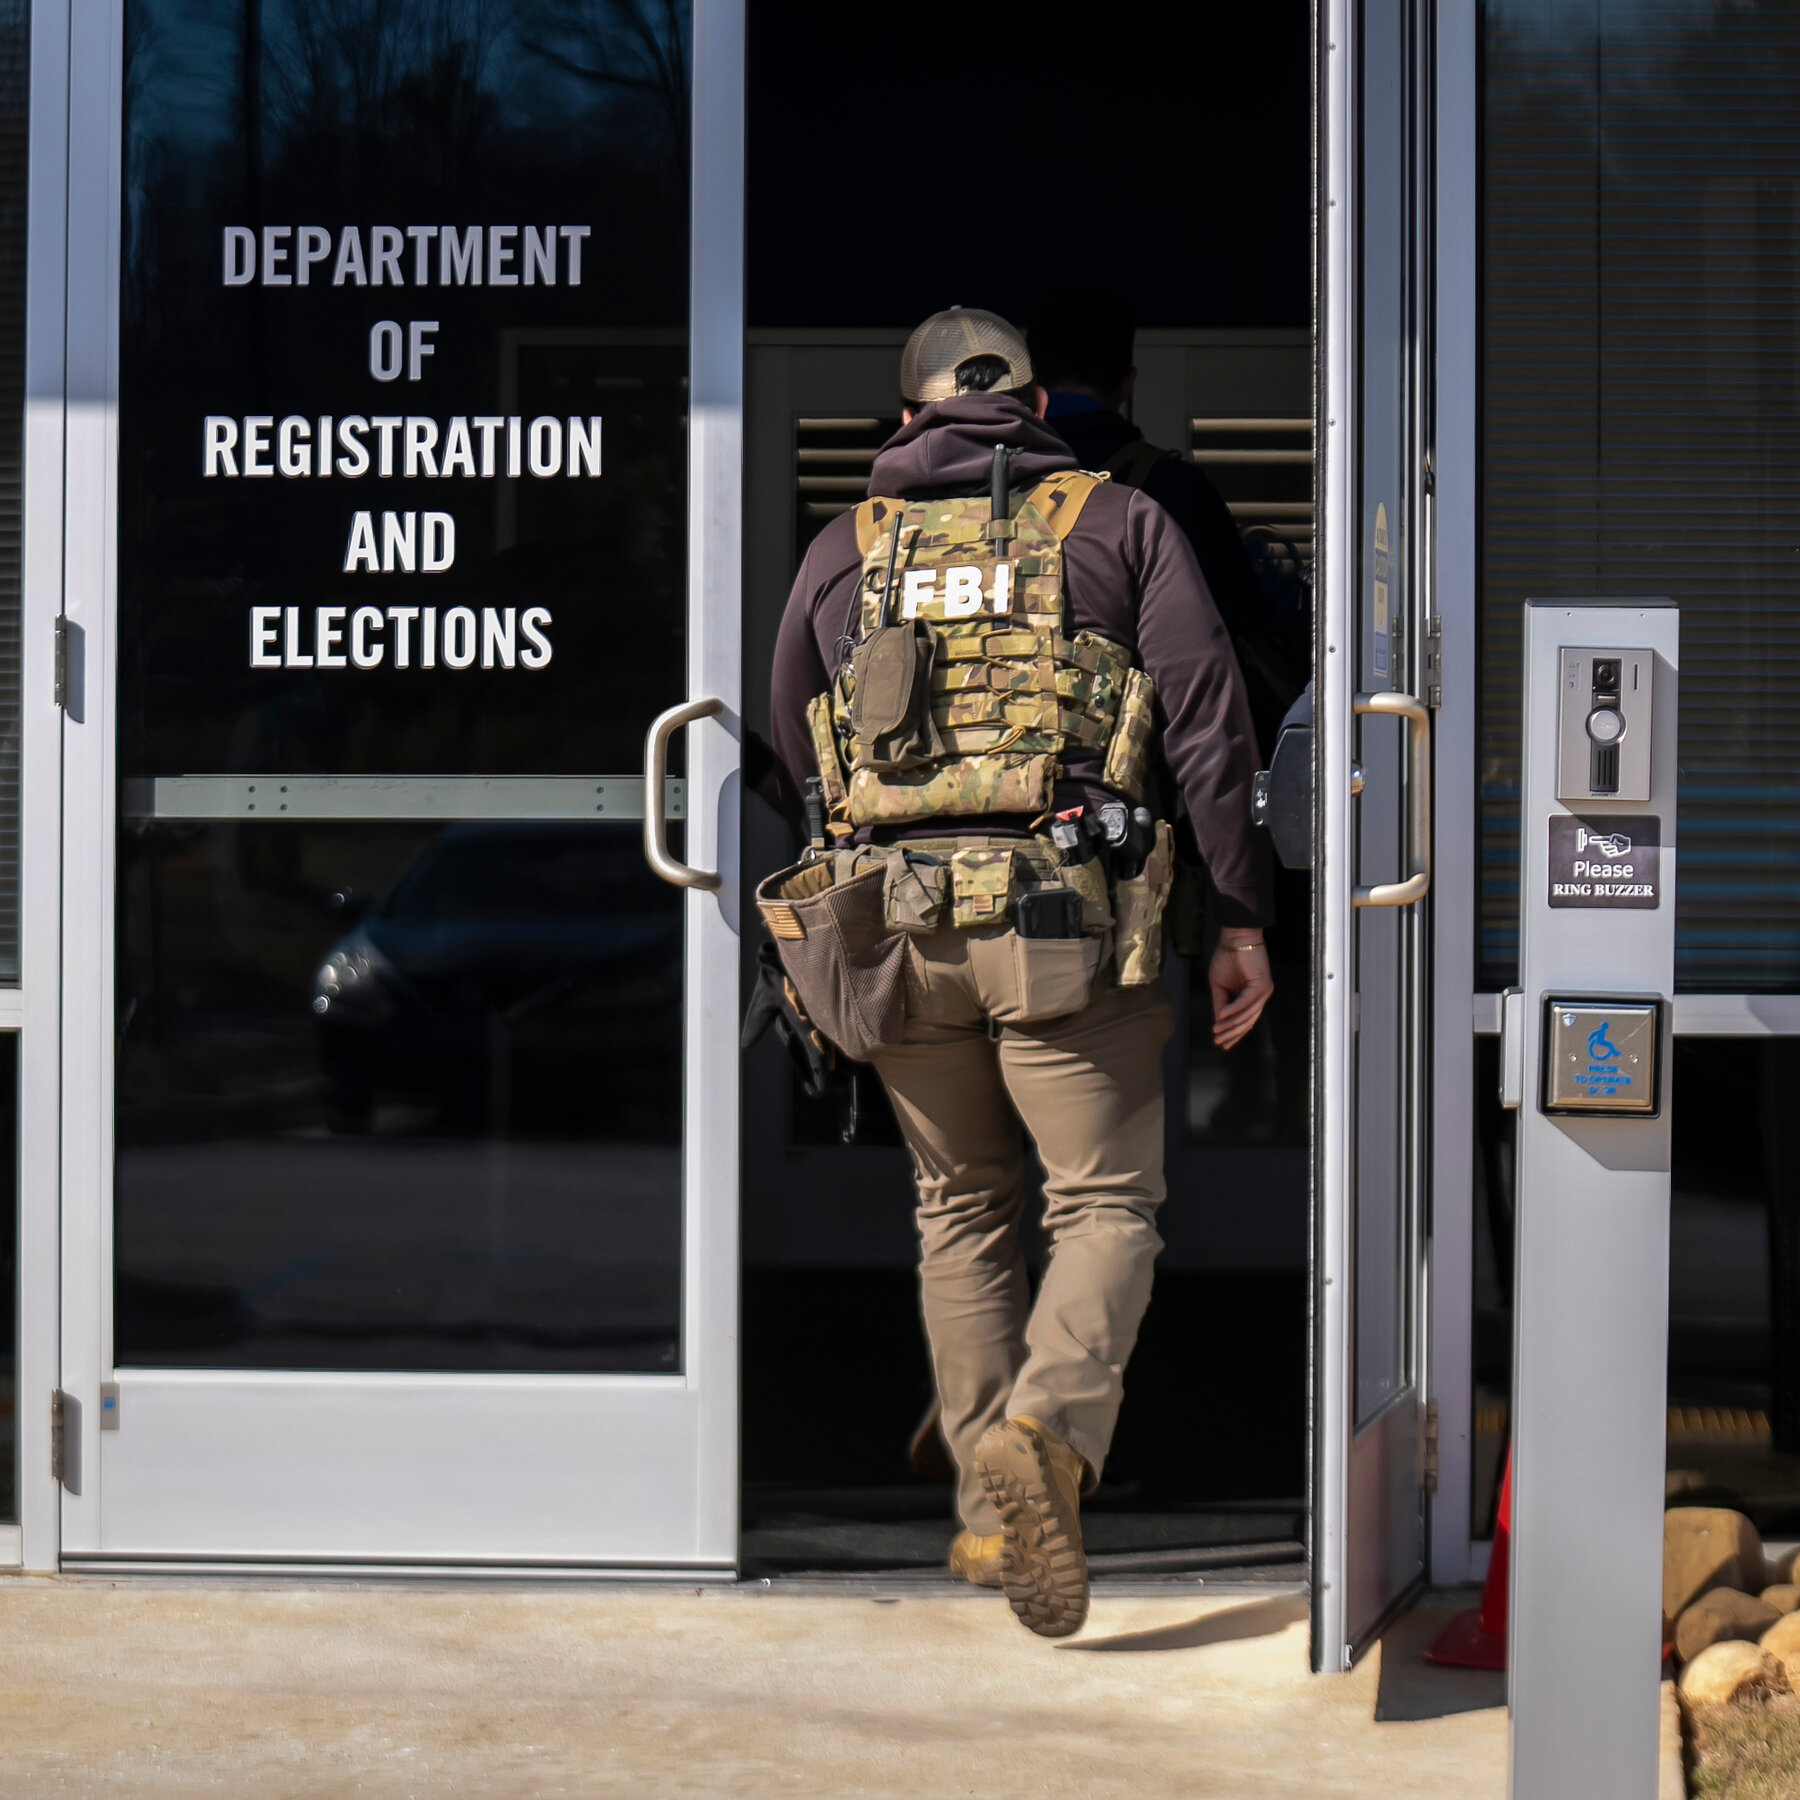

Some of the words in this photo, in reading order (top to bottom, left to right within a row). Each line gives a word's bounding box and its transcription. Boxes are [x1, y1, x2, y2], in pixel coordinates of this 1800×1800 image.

[223, 225, 591, 287] DEPARTMENT
[370, 320, 440, 382] OF
[203, 415, 603, 479] REGISTRATION
[343, 511, 456, 574] AND
[902, 563, 1009, 619] FBI
[249, 605, 553, 670] ELECTIONS
[1553, 883, 1592, 897] RING
[1594, 883, 1654, 898] BUZZER
[1573, 860, 1634, 878] Please
